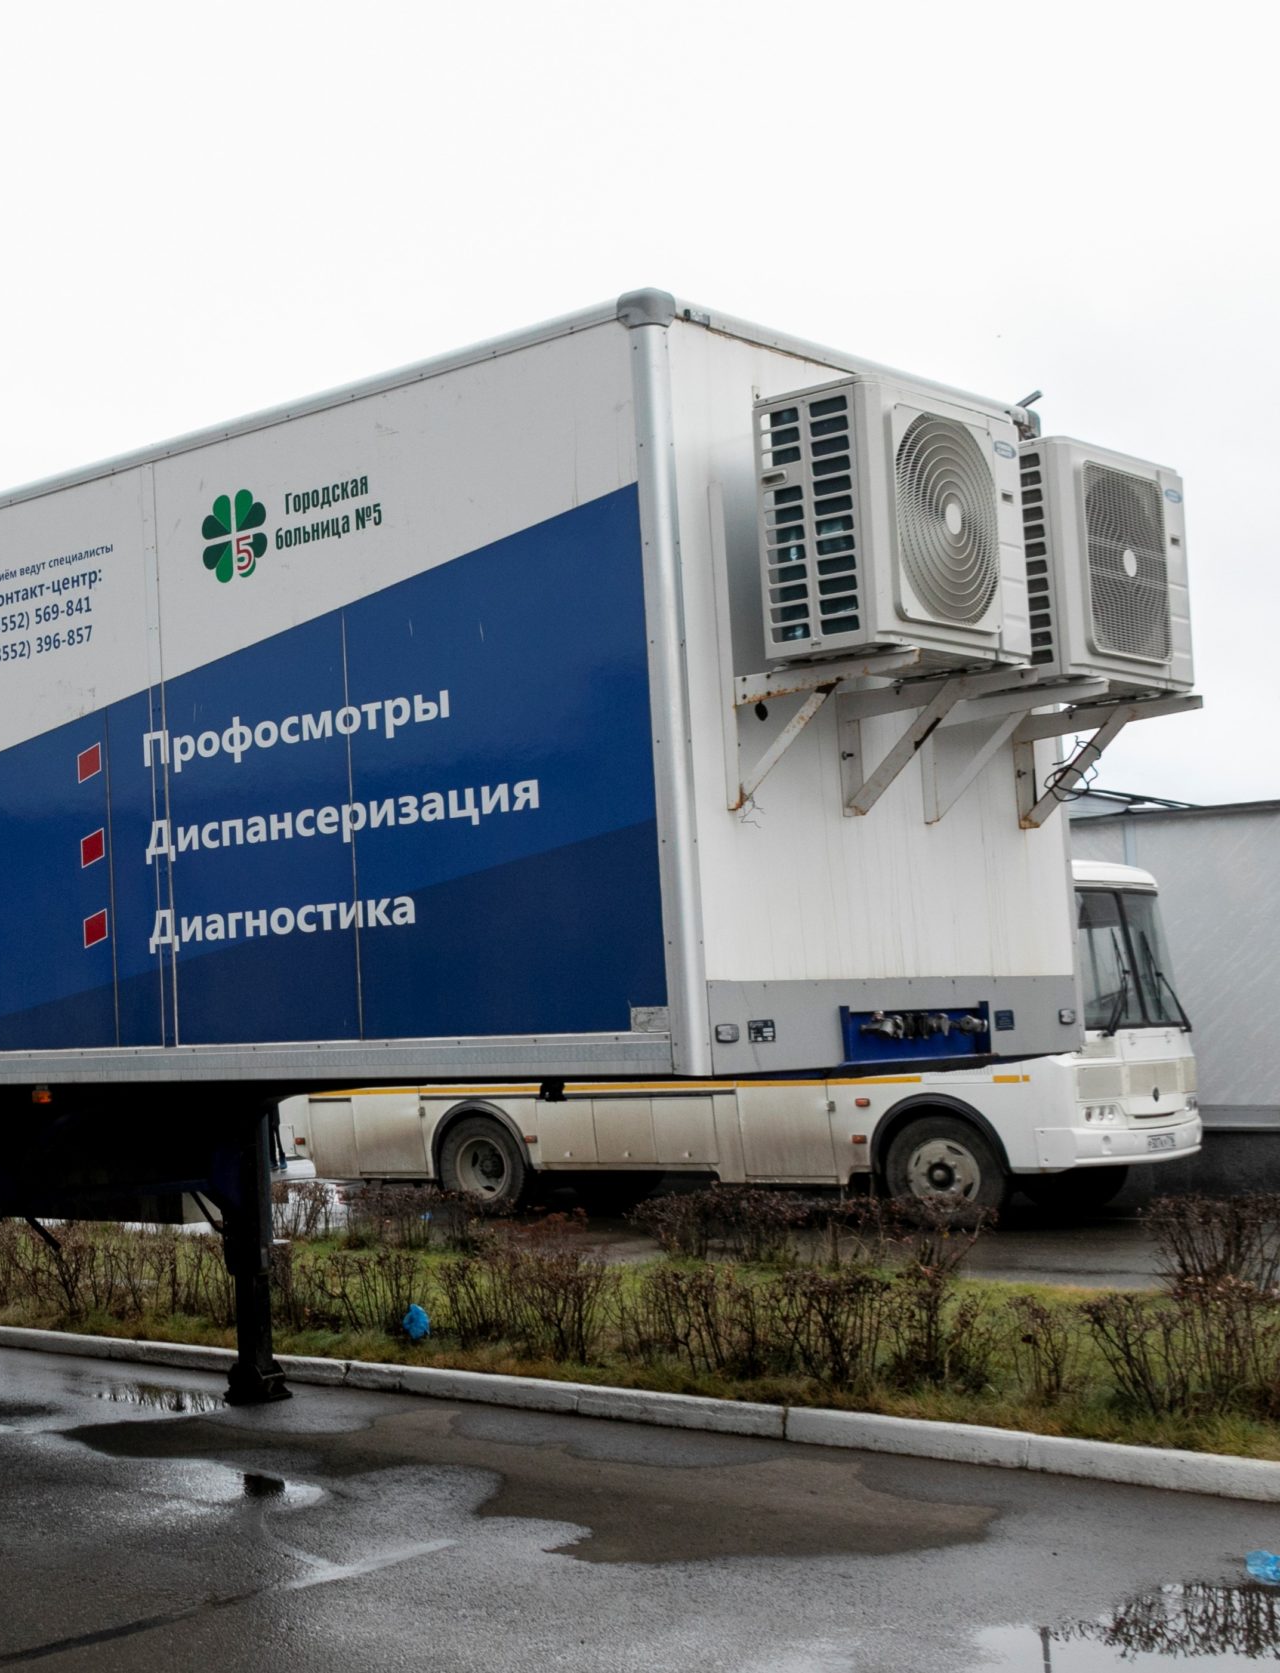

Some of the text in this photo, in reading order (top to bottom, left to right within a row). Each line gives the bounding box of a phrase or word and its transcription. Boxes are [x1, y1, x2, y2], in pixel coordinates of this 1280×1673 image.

[284, 475, 369, 515] Городская
[275, 503, 383, 550] больница №5
[19, 561, 47, 576] ведут
[47, 543, 114, 569] специалисты
[35, 596, 93, 625] 569-841
[36, 625, 93, 654] 396-857
[142, 689, 451, 773] Профосмотры
[145, 779, 541, 864] Диспансеризация
[149, 895, 417, 954] Диагностика
